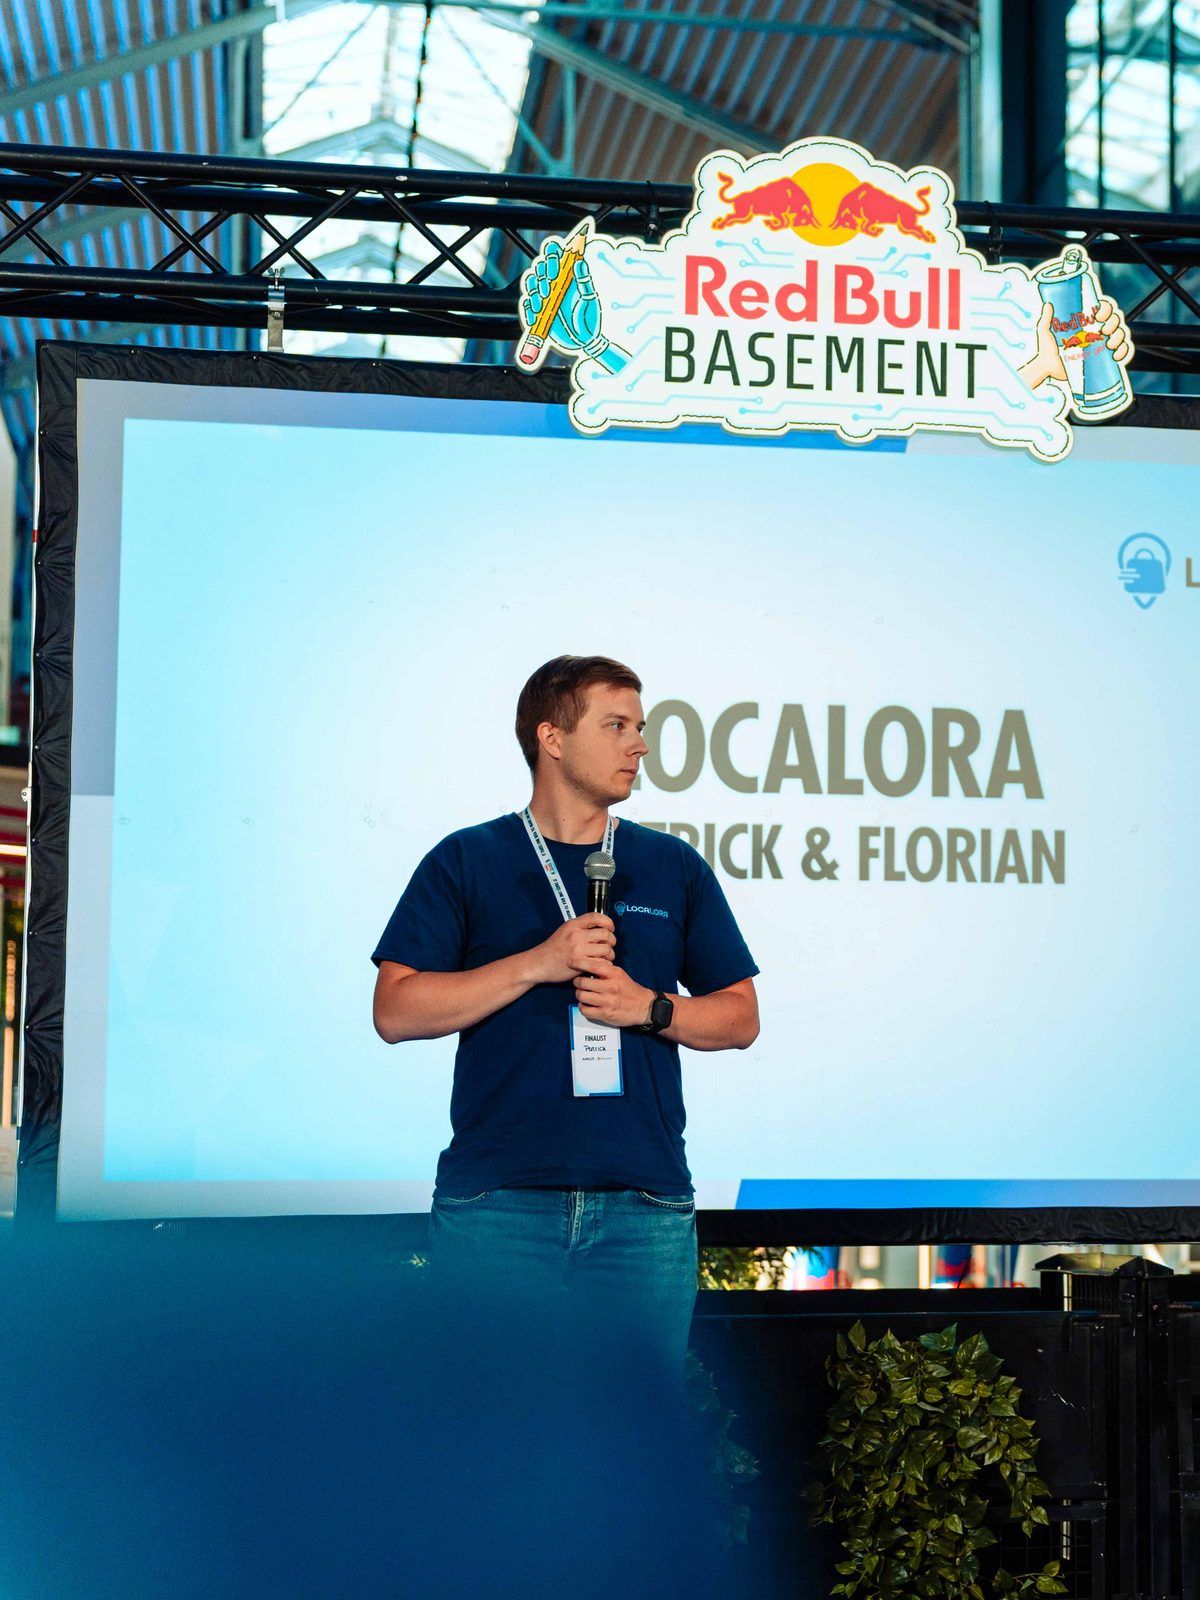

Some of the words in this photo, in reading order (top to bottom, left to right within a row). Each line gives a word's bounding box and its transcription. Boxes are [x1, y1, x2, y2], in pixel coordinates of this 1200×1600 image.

[684, 255, 819, 324] Red
[832, 264, 961, 331] Bull
[1050, 313, 1078, 333] Red
[664, 326, 988, 399] BASEMENT
[633, 698, 1045, 800] OCALORA
[639, 821, 783, 880] ICK
[801, 827, 839, 881] &
[858, 826, 1066, 885] FLORIAN
